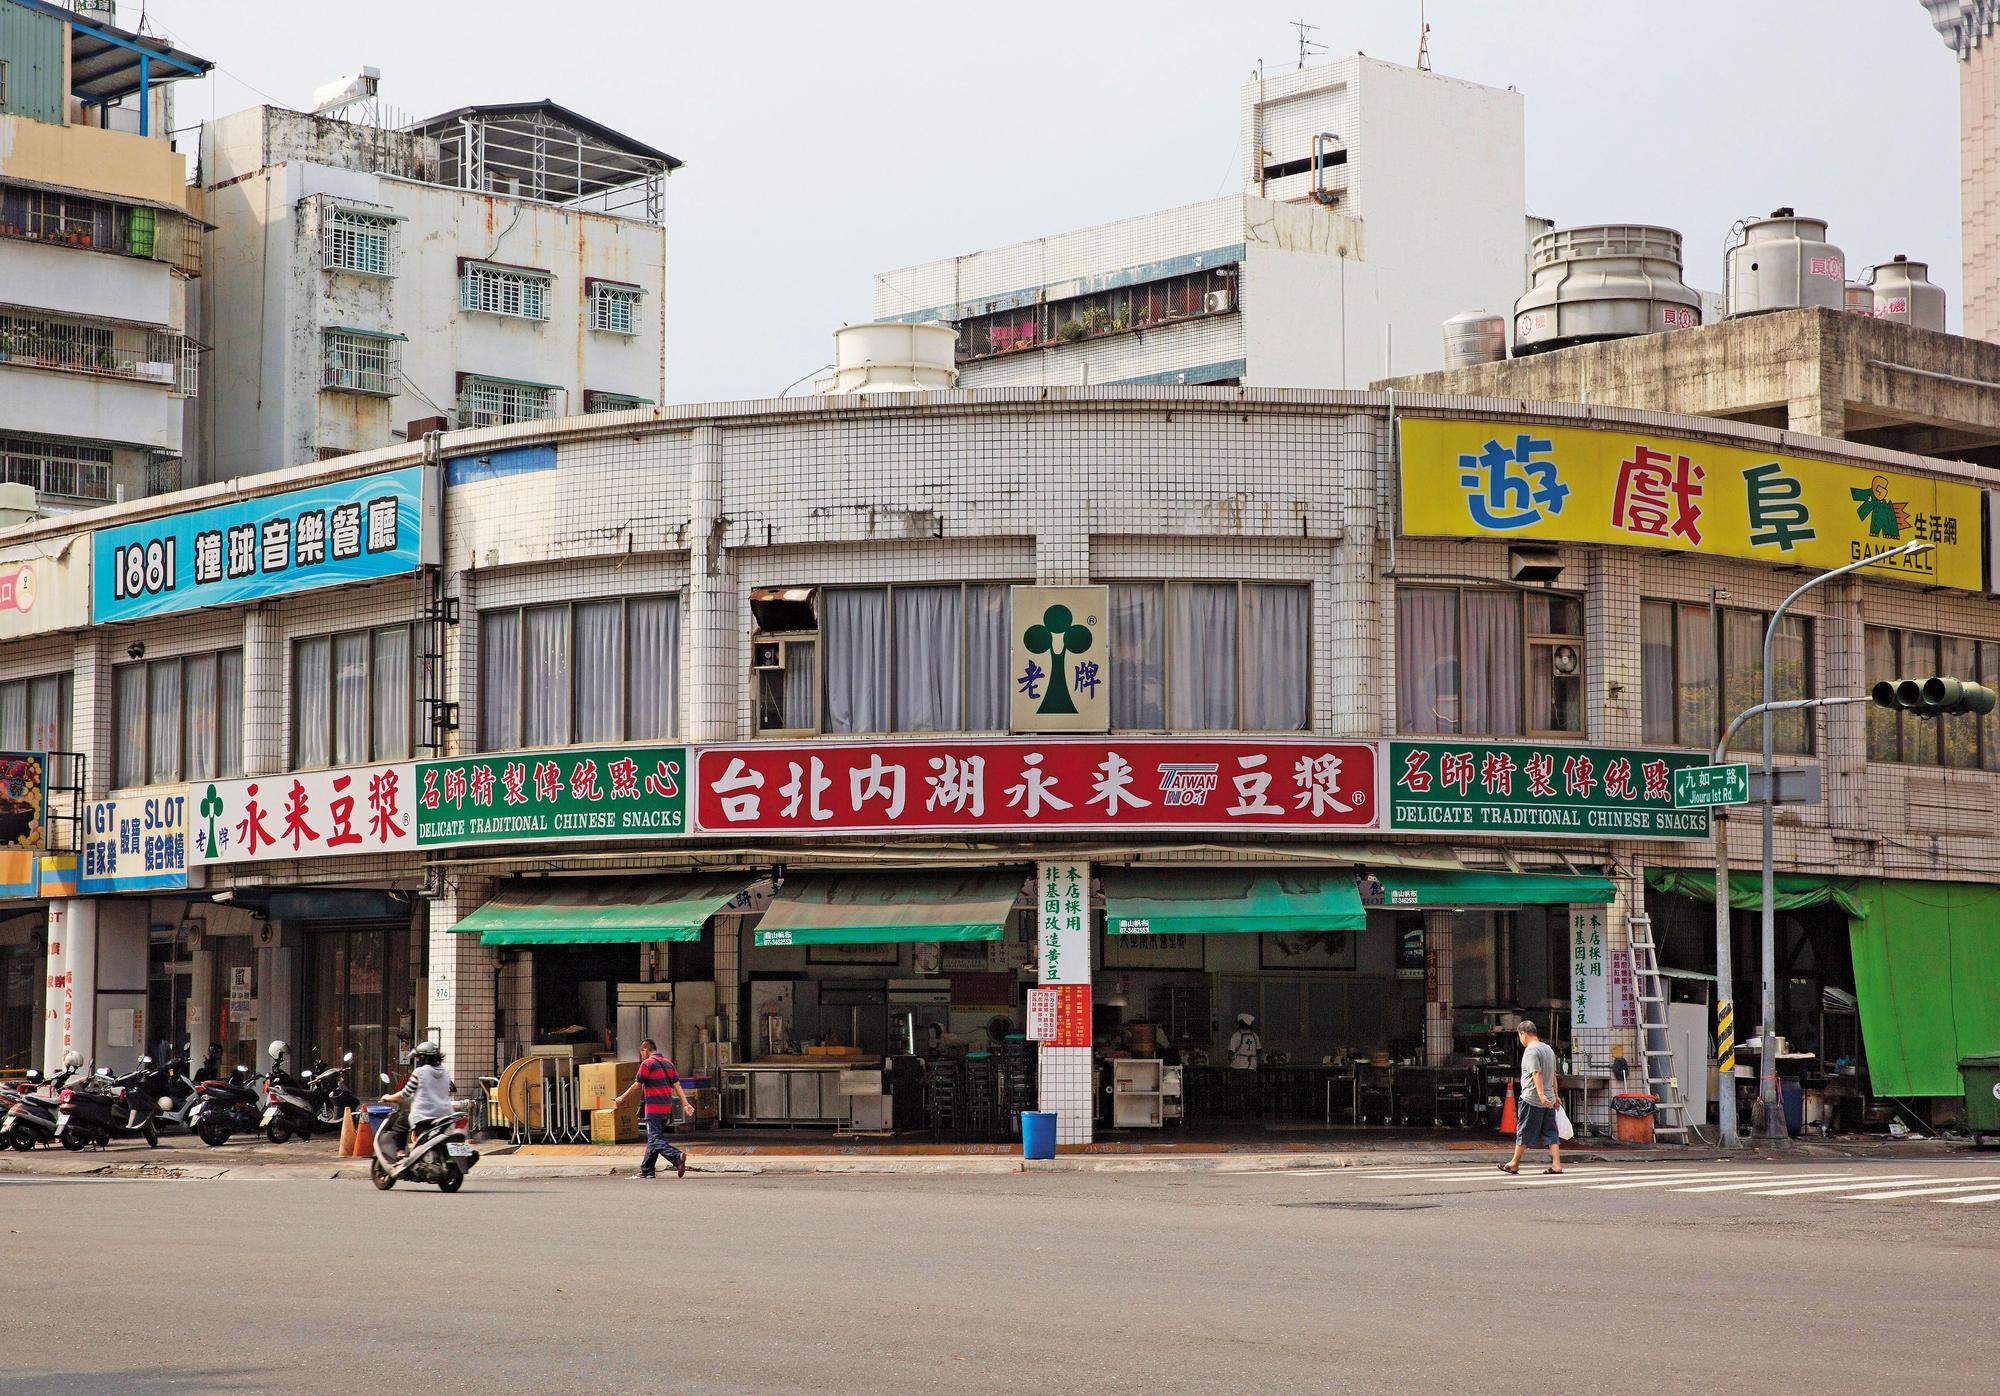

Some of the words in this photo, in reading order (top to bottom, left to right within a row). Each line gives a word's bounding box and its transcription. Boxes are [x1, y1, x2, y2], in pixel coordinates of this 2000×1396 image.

[1458, 433, 1815, 552] 遊戲阜
[1914, 512, 1957, 545] 生活網
[115, 537, 175, 599] 1881
[196, 496, 398, 584] 撞球音樂餐廳
[1851, 541, 1897, 566] GAME
[419, 756, 680, 811] 名師精製傳統點心
[1157, 763, 1219, 790] TAIWAN
[1226, 753, 1354, 817] 豆漿
[1397, 749, 1678, 803] 名師精製傳統點
[1685, 768, 1737, 788] 九如一路
[1689, 789, 1711, 804] Jiouru
[1712, 788, 1722, 802] 1st
[86, 802, 117, 835] IGT
[144, 796, 185, 830] SLOT
[419, 819, 465, 839] DELICATE
[470, 815, 547, 834] TRADITIONAL
[554, 812, 615, 830] CHINESE
[622, 810, 682, 828] SNACKS
[1395, 805, 1473, 823] DELICATE
[1481, 807, 1581, 826] TRADITIONAL
[1588, 810, 1650, 829] CHINESE
[1656, 814, 1707, 831] SNACKS
[86, 839, 117, 875] 百家樂
[1065, 866, 1083, 932] 本店採用
[1589, 914, 1602, 977] 本店採用
[435, 988, 448, 998] 976
